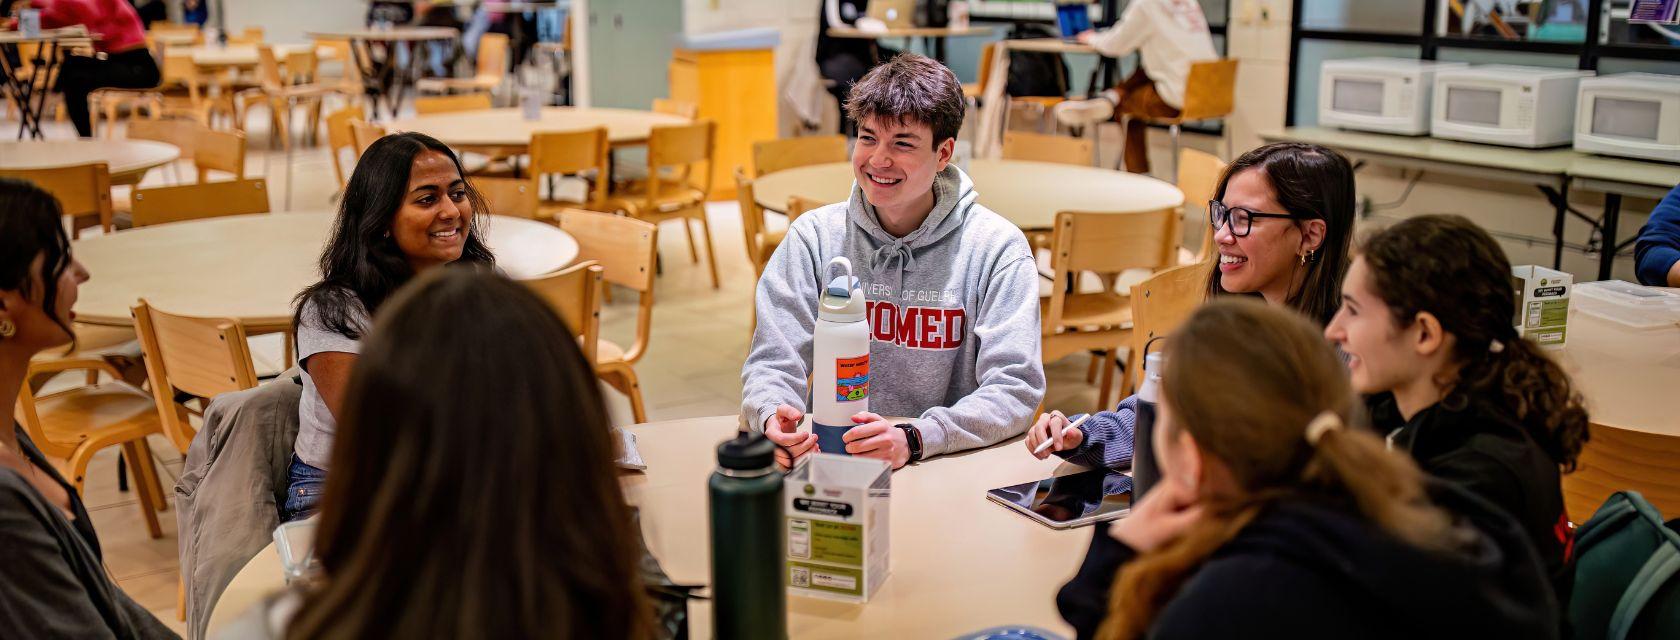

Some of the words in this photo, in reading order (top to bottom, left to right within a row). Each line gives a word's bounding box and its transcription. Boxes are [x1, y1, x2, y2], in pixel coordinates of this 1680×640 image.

[902, 290, 916, 301] OF
[917, 289, 956, 303] GUELPH
[865, 300, 967, 351] IOMED
